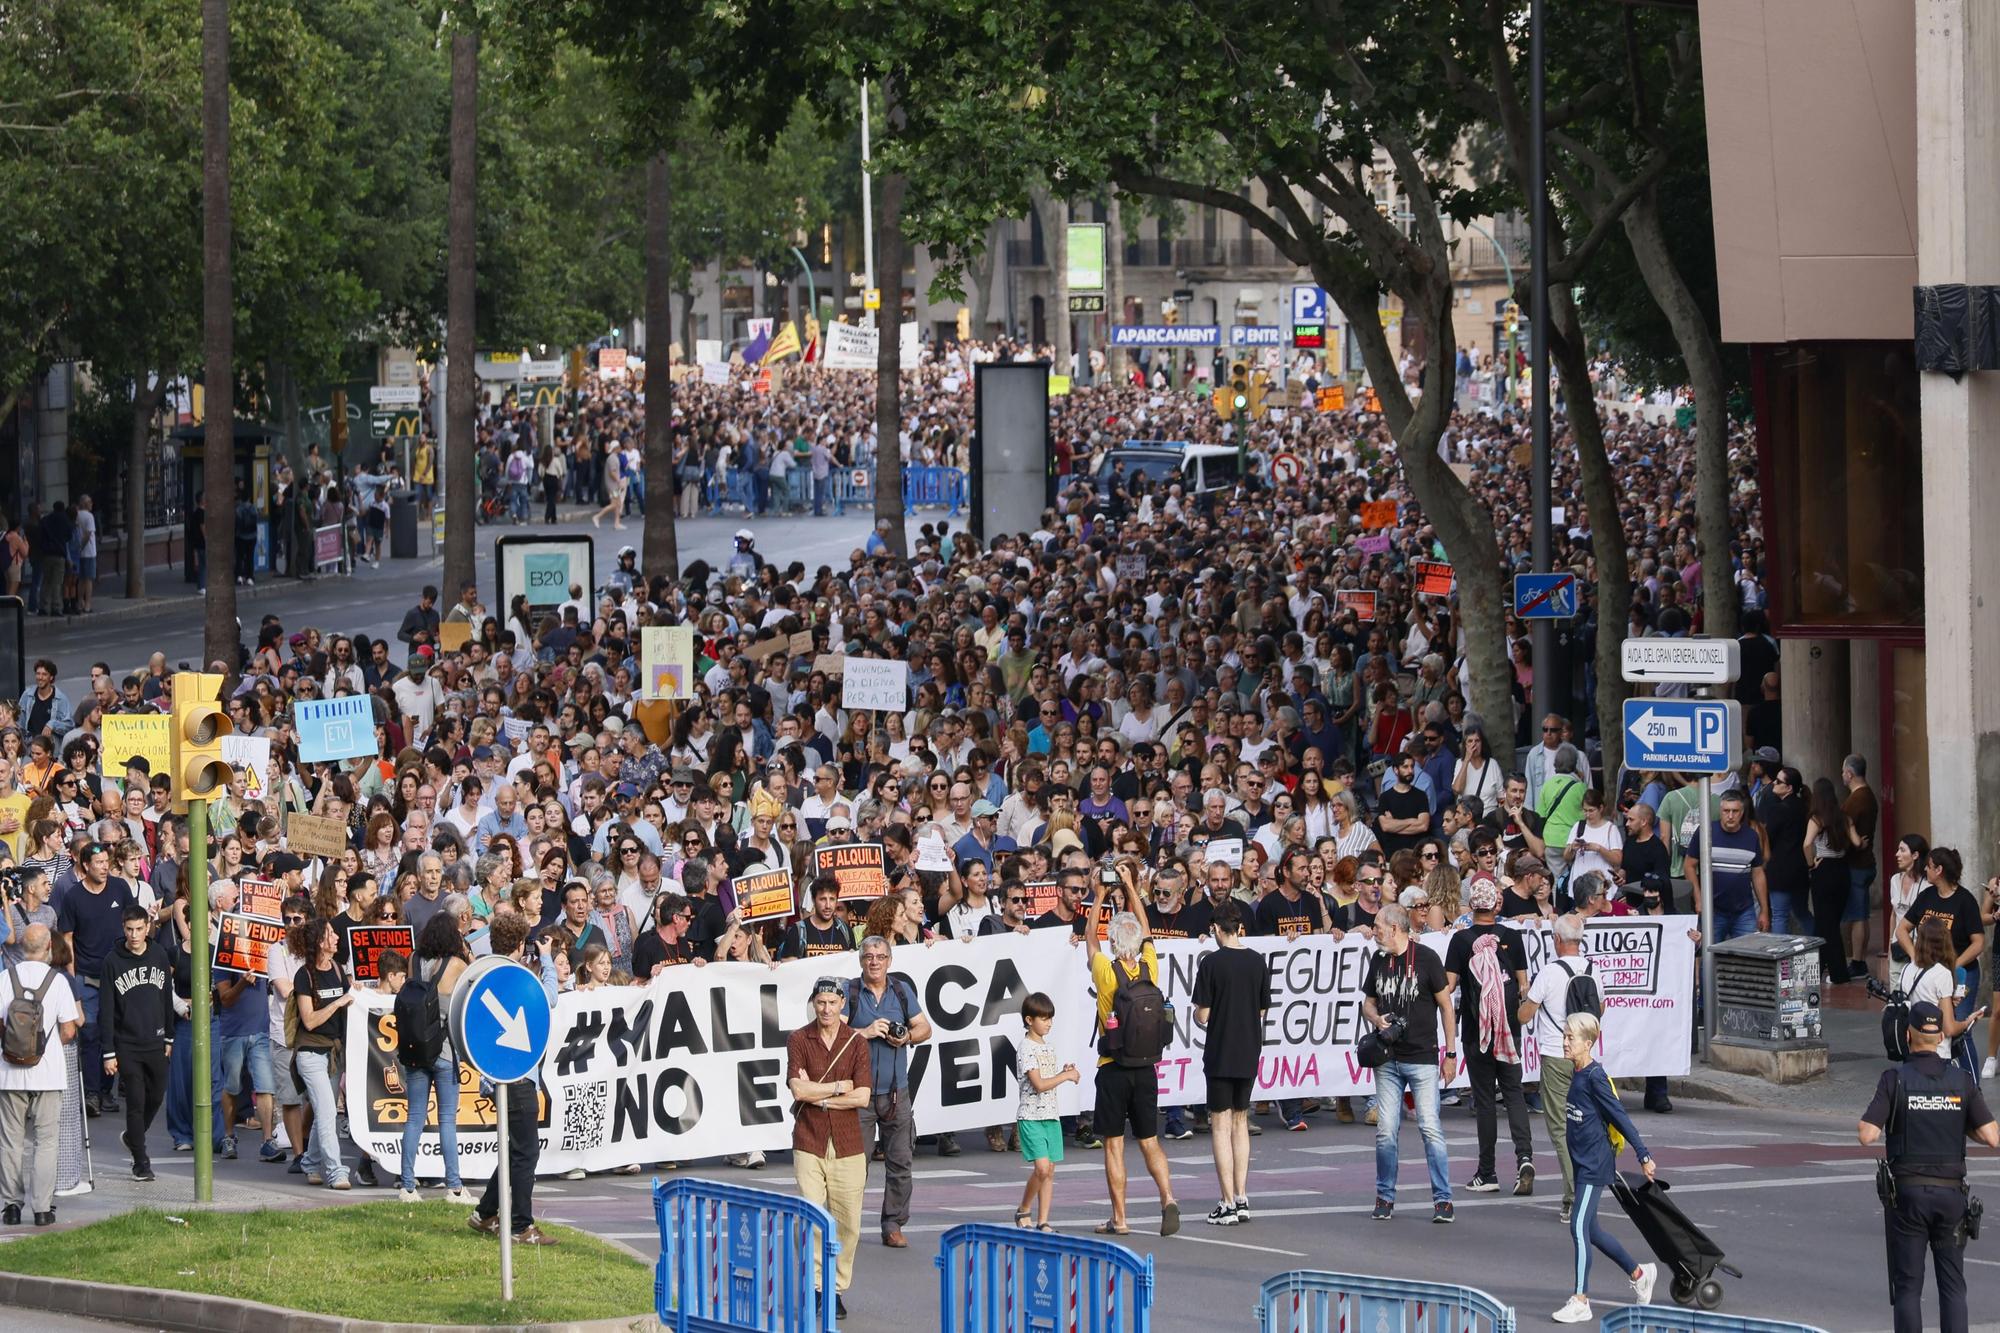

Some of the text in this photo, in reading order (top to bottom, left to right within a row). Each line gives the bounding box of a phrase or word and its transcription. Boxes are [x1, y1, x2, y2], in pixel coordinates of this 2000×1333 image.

[1117, 328, 1216, 342] APARCAMENT
[530, 570, 564, 587] B20
[1644, 648, 1655, 662] DEL
[1655, 648, 1671, 662] GRAN
[1673, 648, 1698, 664] GENERAL
[1700, 648, 1724, 664] CONSELL
[1647, 723, 1677, 736] 250 m
[1701, 712, 1719, 748] P
[1643, 754, 1710, 763] PARKING PLAZA ESPAÑA
[820, 848, 881, 868] SE ALQUILA
[243, 883, 252, 894] SE
[736, 872, 788, 894] SE ALQUILA
[1035, 886, 1056, 897] ALQUI
[223, 918, 286, 941] SE VENDE
[1151, 927, 1188, 937] MALLORCA
[353, 931, 410, 946] SE VENDE
[1595, 931, 1654, 952] LLOGA
[1613, 957, 1626, 968] no
[1631, 955, 1644, 969] ho
[115, 966, 165, 995] NIKE AIR
[1614, 971, 1645, 986] pagar
[1259, 1053, 1320, 1090] UNA
[611, 1067, 704, 1144] NO
[1908, 1095, 1951, 1103] POLICIA
[1908, 1102, 1961, 1111] NACIONAL
